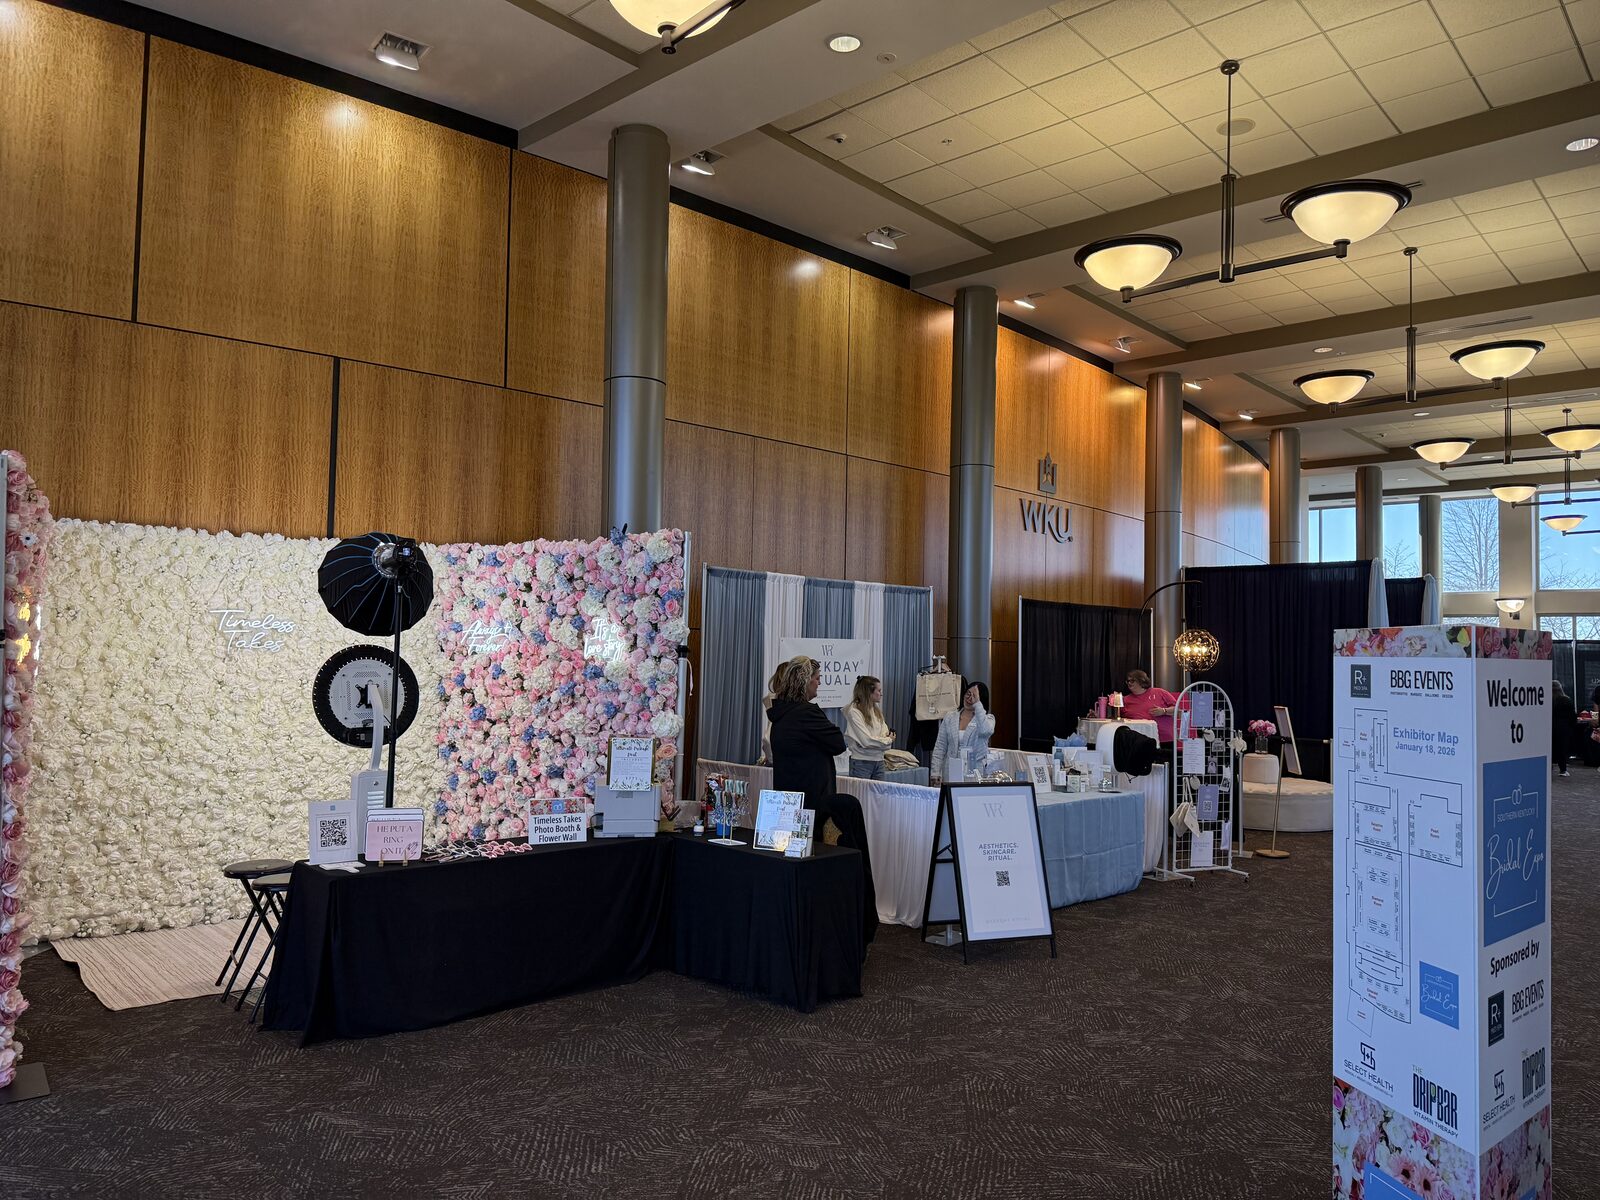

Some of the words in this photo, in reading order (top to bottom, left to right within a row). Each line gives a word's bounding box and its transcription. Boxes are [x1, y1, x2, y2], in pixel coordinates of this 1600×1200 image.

[1019, 498, 1073, 544] WKU
[209, 609, 297, 633] Timeless
[223, 629, 285, 655] Takes
[1390, 669, 1411, 689] BBG
[1414, 670, 1454, 691] EVENTS
[1487, 678, 1545, 708] Welcome
[1393, 727, 1435, 742] Exhibitor
[1437, 731, 1459, 747] Map
[1510, 720, 1524, 744] to
[1395, 741, 1423, 754] January
[1425, 744, 1436, 755] 18,
[1437, 746, 1456, 756] 2026
[376, 825, 389, 833] HE
[534, 816, 562, 825] Timeless
[563, 815, 582, 824] Takes
[534, 825, 554, 834] Photo
[555, 824, 575, 832] Booth
[383, 836, 404, 844] RING
[538, 834, 561, 843] Flower
[562, 833, 577, 841] Wall
[979, 842, 1019, 850] AESTHETICS.
[1486, 833, 1520, 900] Bridal
[1523, 828, 1544, 881] Expo
[1490, 941, 1530, 978] Sponsored
[1531, 939, 1540, 959] by
[1512, 989, 1524, 1015] BBG
[1524, 979, 1545, 1008] EVENTS
[1343, 1059, 1368, 1077] SELECT
[1368, 1073, 1394, 1093] HEALTH
[1412, 1064, 1423, 1075] THE
[1413, 1110, 1434, 1126] VITAMIN
[1434, 1120, 1459, 1138] THERAPY
